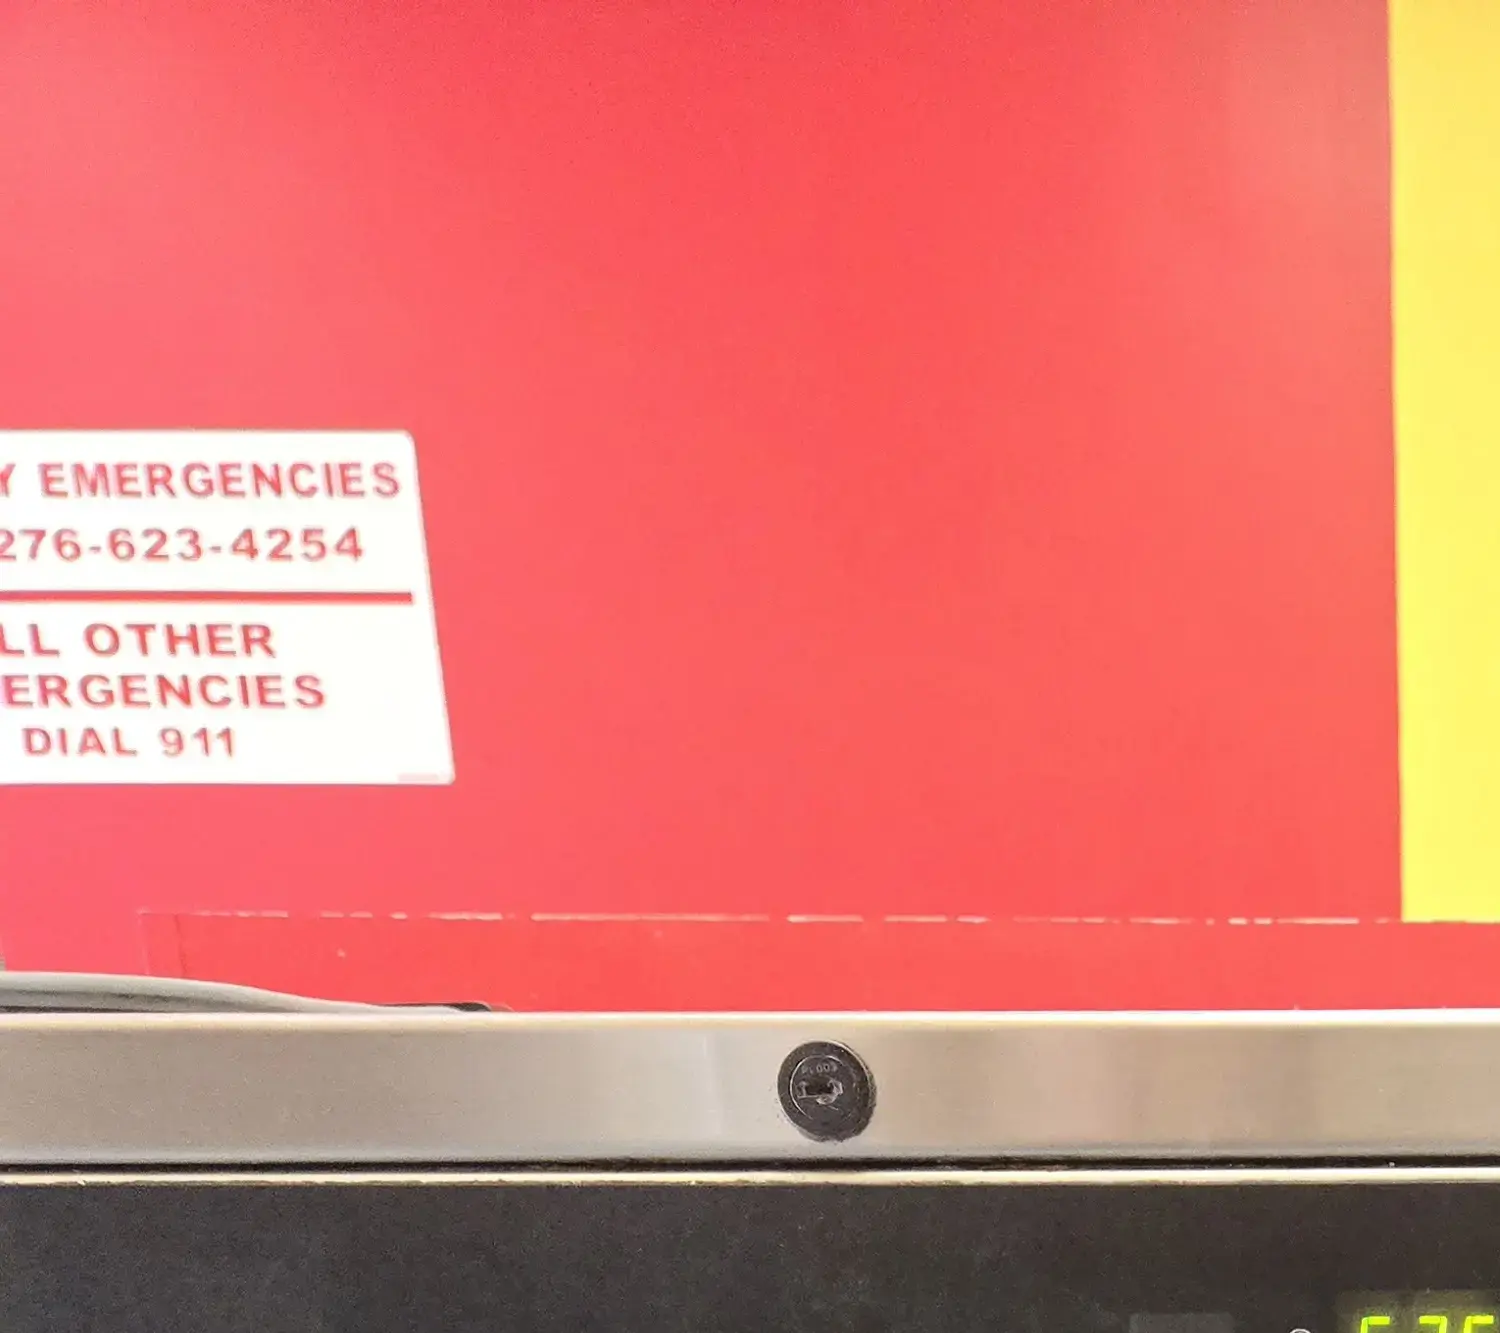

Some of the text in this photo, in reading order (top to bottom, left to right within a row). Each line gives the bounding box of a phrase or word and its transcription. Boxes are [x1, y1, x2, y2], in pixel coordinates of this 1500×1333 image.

[39, 462, 401, 498] EMERGENCIES
[0, 527, 364, 562] 276-623-4254
[83, 623, 277, 658] OTHER
[22, 726, 236, 757] DIAL 911
